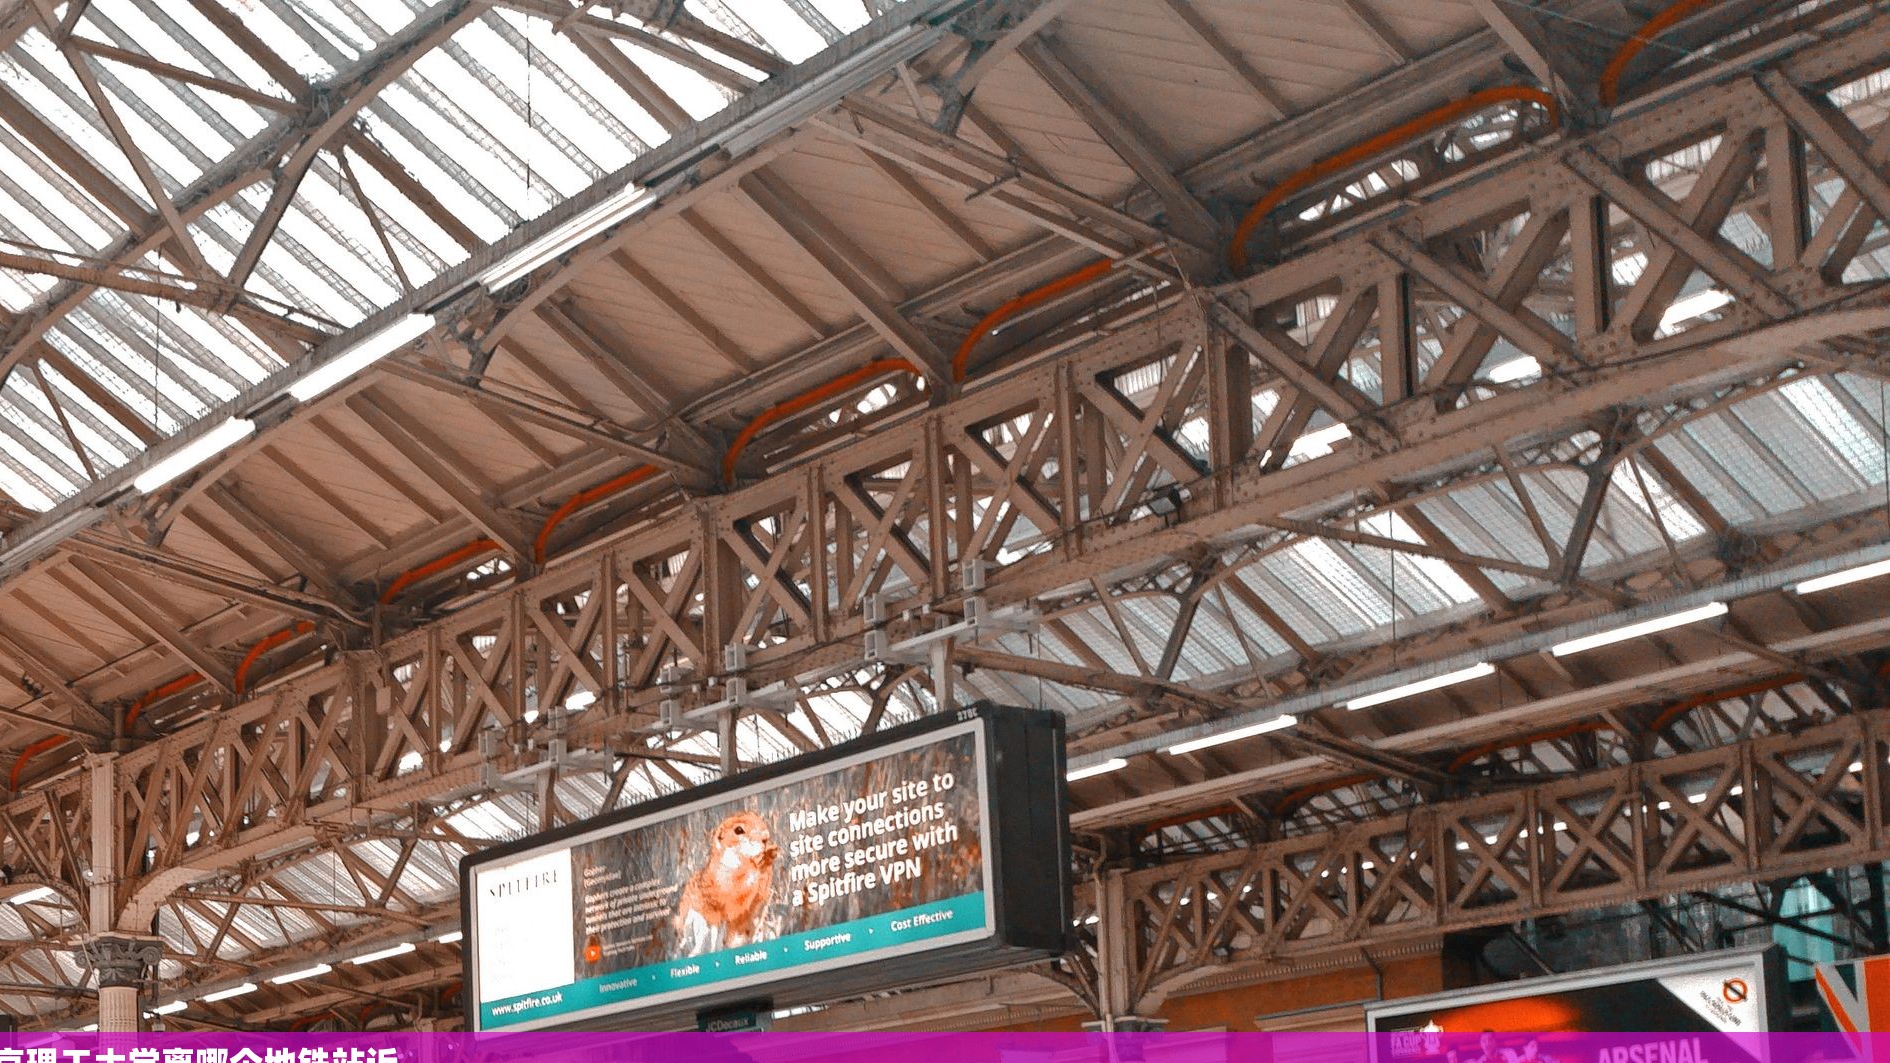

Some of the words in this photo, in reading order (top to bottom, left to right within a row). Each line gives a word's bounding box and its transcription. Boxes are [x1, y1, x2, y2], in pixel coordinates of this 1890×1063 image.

[789, 804, 840, 832] Make
[842, 791, 887, 822] your
[892, 780, 928, 804] site
[932, 773, 954, 790] to
[790, 835, 823, 858] site
[827, 802, 944, 847] connections
[791, 855, 841, 882] more
[844, 838, 908, 869] secure
[912, 822, 958, 850] with
[792, 890, 804, 906] a
[808, 871, 876, 906] Spitfire
[879, 857, 921, 885] VPN
[492, 992, 563, 1016] www.spitfire.co.uk
[600, 978, 637, 993] Innovative
[670, 964, 700, 978] Flexible
[735, 950, 767, 965] Reliable
[804, 931, 851, 951] Supportive
[890, 918, 911, 932] Cost
[913, 909, 953, 926] Effective
[706, 1017, 750, 1032] JCDecaux
